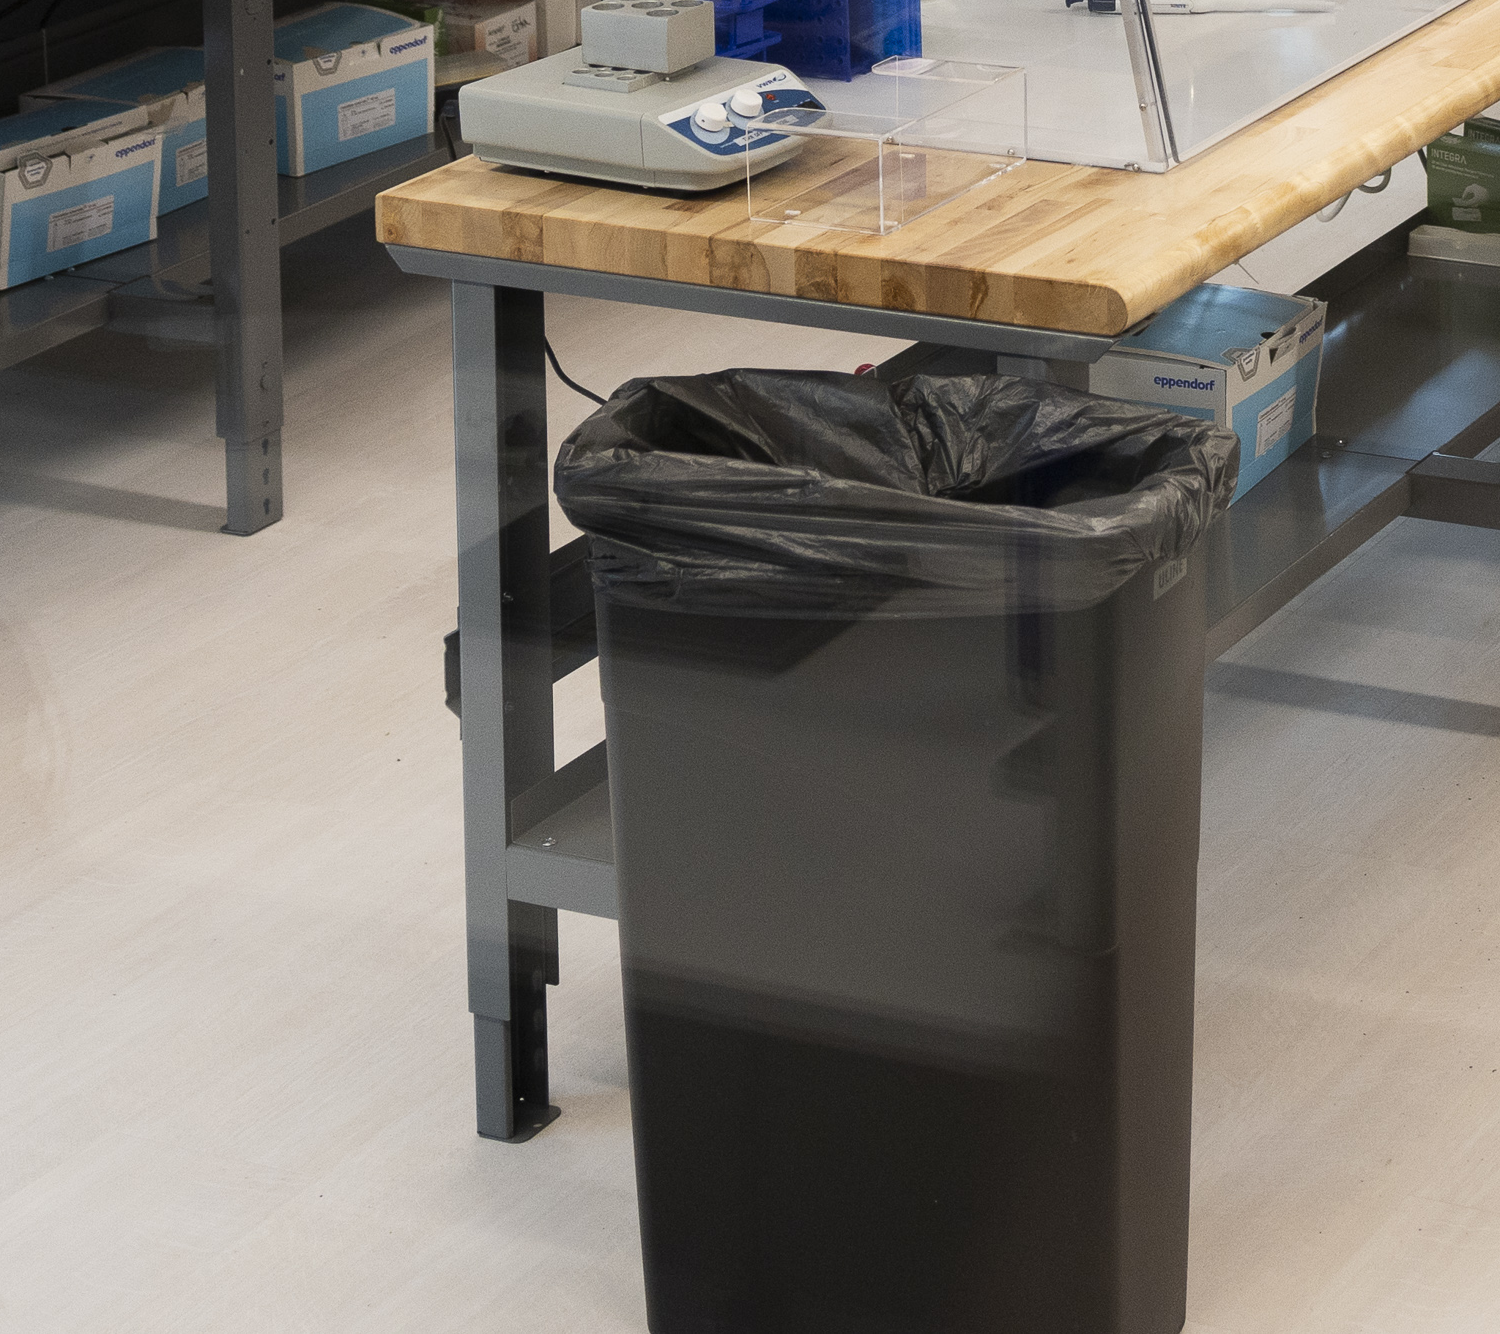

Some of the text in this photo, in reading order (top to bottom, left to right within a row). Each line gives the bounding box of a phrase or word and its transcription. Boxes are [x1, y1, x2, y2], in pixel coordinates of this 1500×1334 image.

[388, 35, 429, 55] eppendorf
[756, 78, 775, 89] VWR
[1468, 129, 1500, 144] INTEGRA
[115, 137, 156, 160] eppendorf
[1431, 148, 1467, 165] INTEGRA
[1298, 316, 1325, 345] eppendorf
[1153, 374, 1216, 392] eppendorf
